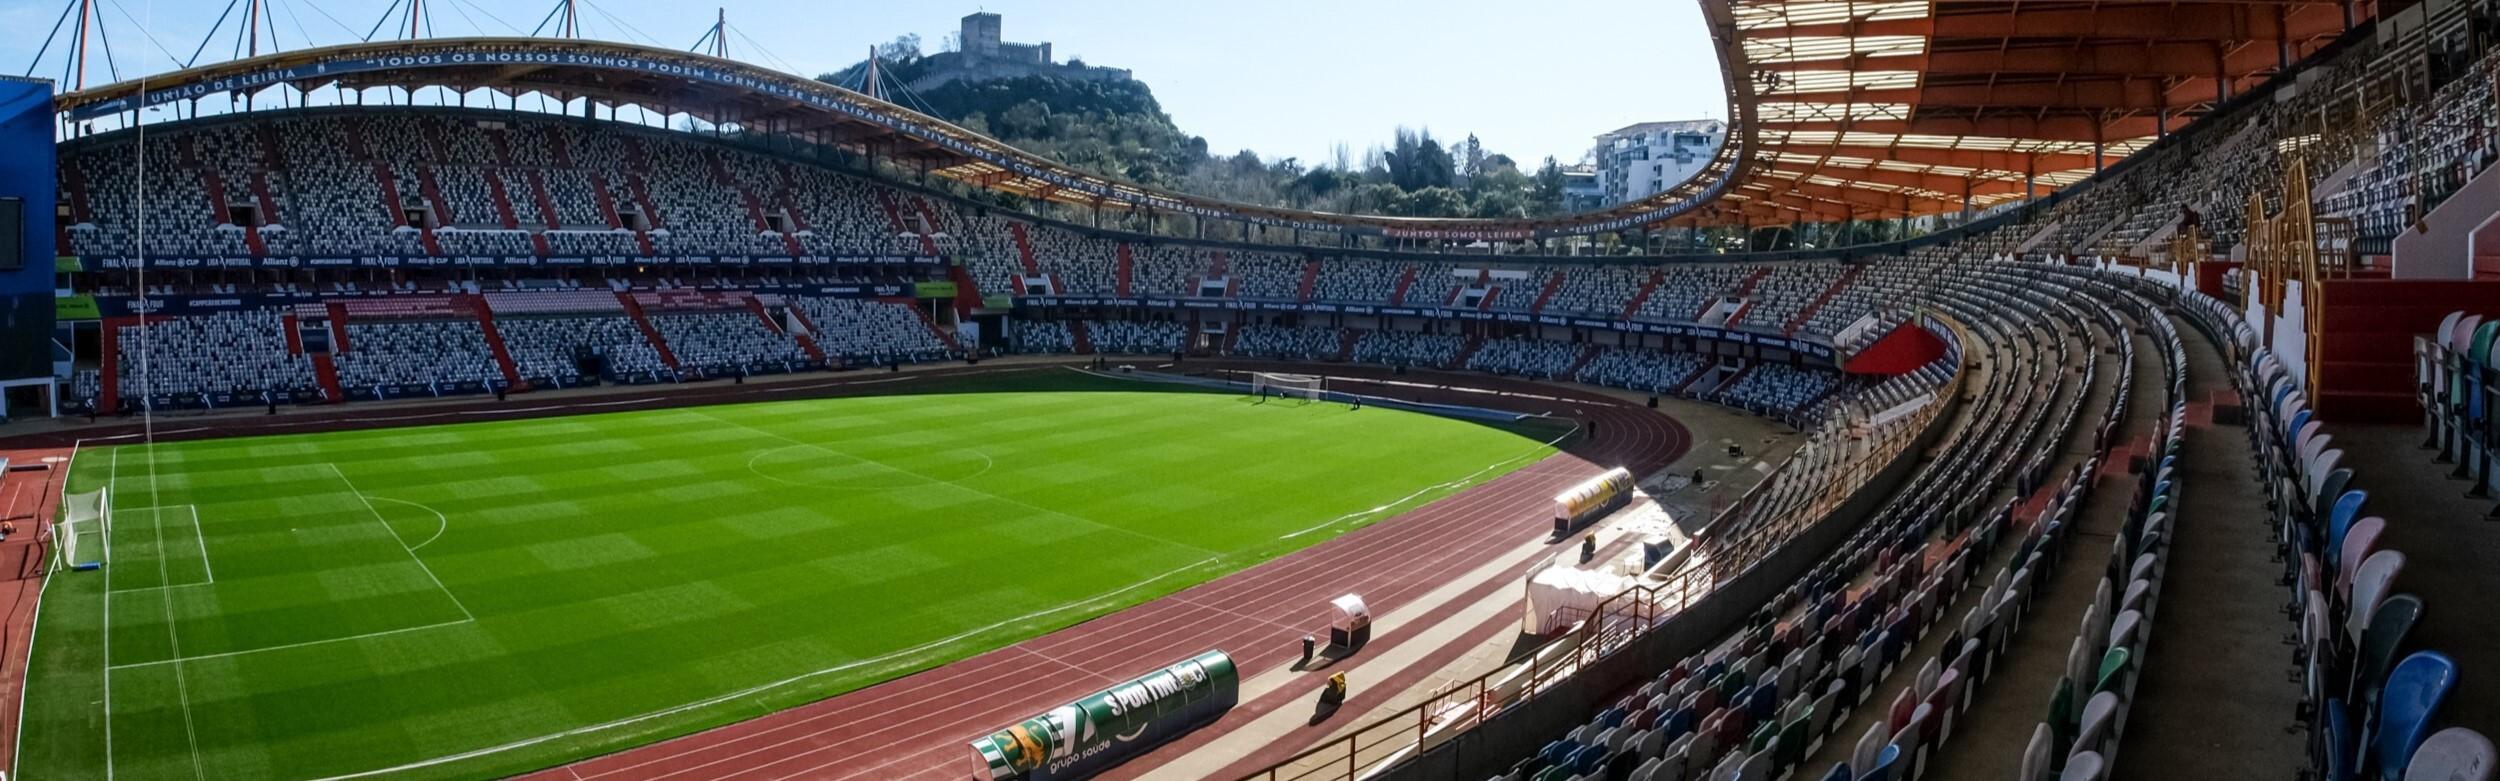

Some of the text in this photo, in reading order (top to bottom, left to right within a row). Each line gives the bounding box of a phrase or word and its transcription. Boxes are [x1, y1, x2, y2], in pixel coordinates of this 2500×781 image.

[151, 69, 296, 103] UNIÃO DE LEIRIA
[452, 53, 476, 62] OS
[486, 53, 559, 63] NOSSOS
[568, 54, 639, 69] SONHOS
[648, 62, 705, 78] PODEM
[714, 72, 804, 99] TORNAR-SE
[811, 96, 894, 125] REALIDADE
[900, 121, 917, 133] SE
[922, 130, 992, 160] TIVERMOS
[1014, 163, 1083, 189] CORAGEM
[1089, 185, 1107, 195] DE
[1114, 191, 1132, 200] OS
[1250, 215, 1343, 232] WALT DISNEY
[1395, 230, 1522, 239] JUNTOS SOMOS LEIRIA
[102, 258, 121, 268] FINAL
[154, 258, 177, 266] Allianz
[361, 256, 377, 266] FINAL
[504, 256, 528, 264] Allianz
[1050, 753, 1080, 775] grupo
